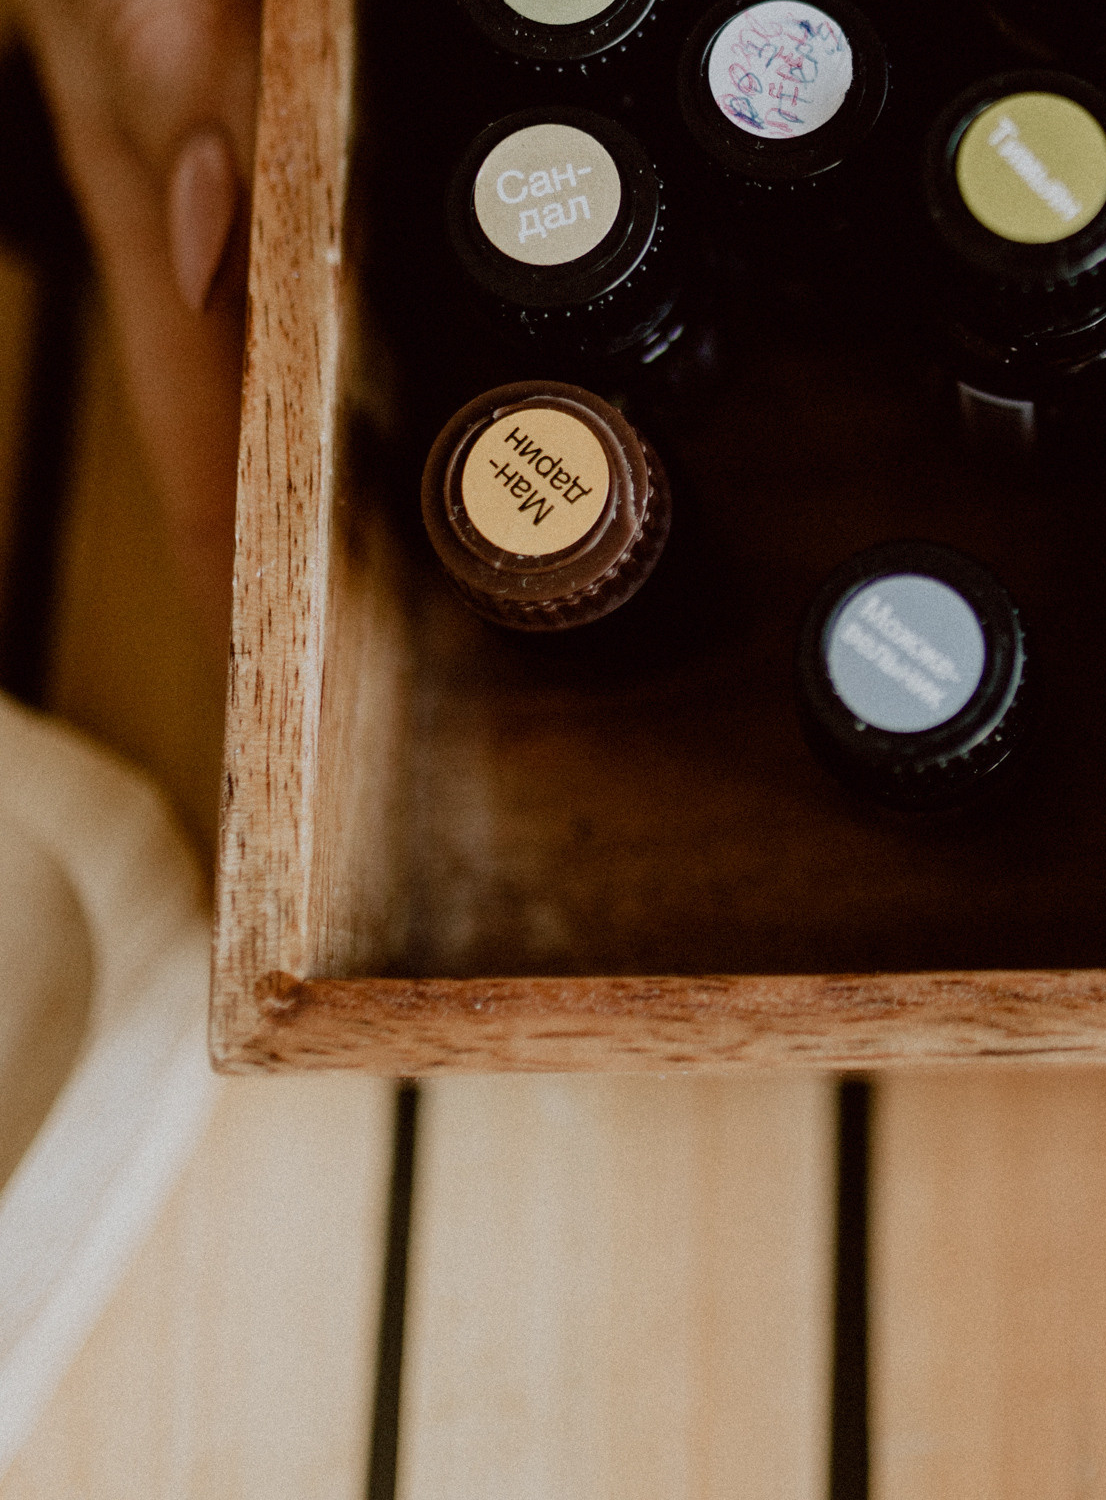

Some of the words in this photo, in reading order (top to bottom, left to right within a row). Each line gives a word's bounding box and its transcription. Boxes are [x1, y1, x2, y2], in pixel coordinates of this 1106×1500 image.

[496, 163, 593, 205] Сан-
[518, 195, 591, 244] дал
[489, 459, 555, 527] Ман-
[503, 426, 593, 505] дарин
